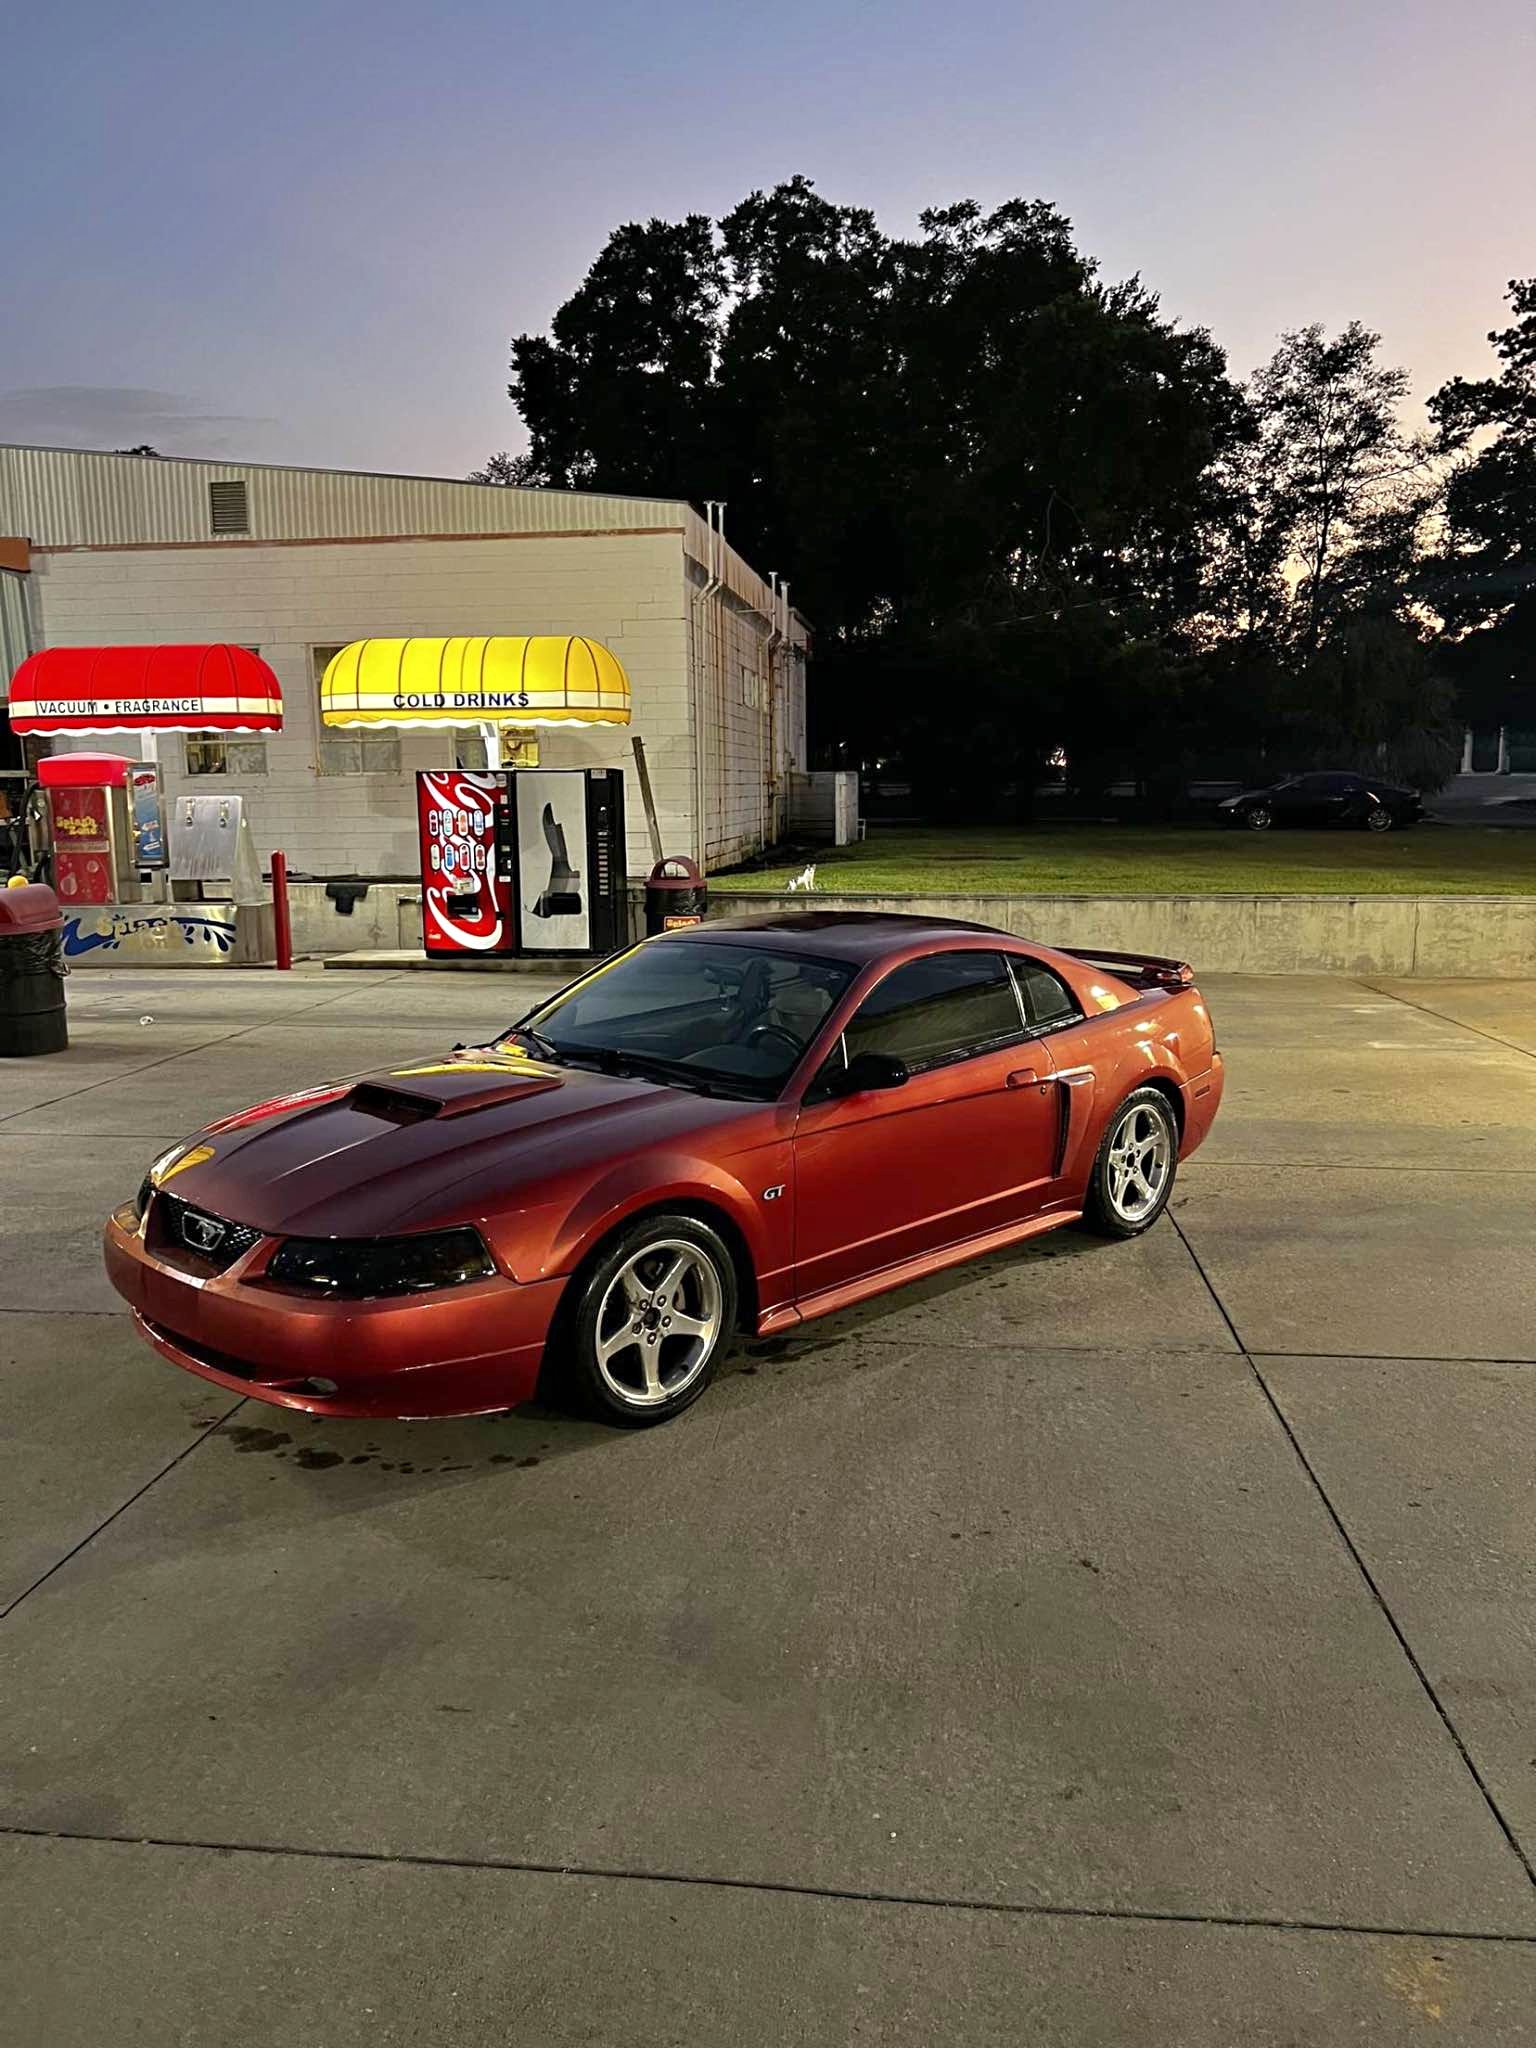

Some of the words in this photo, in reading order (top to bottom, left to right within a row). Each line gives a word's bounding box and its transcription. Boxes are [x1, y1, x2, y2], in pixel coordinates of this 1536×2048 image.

[39, 701, 98, 714] VACUUM
[115, 699, 199, 713] FRAGRANCE
[393, 693, 446, 708] COLD
[453, 692, 529, 707] DRINKS
[763, 1184, 786, 1200] GT
